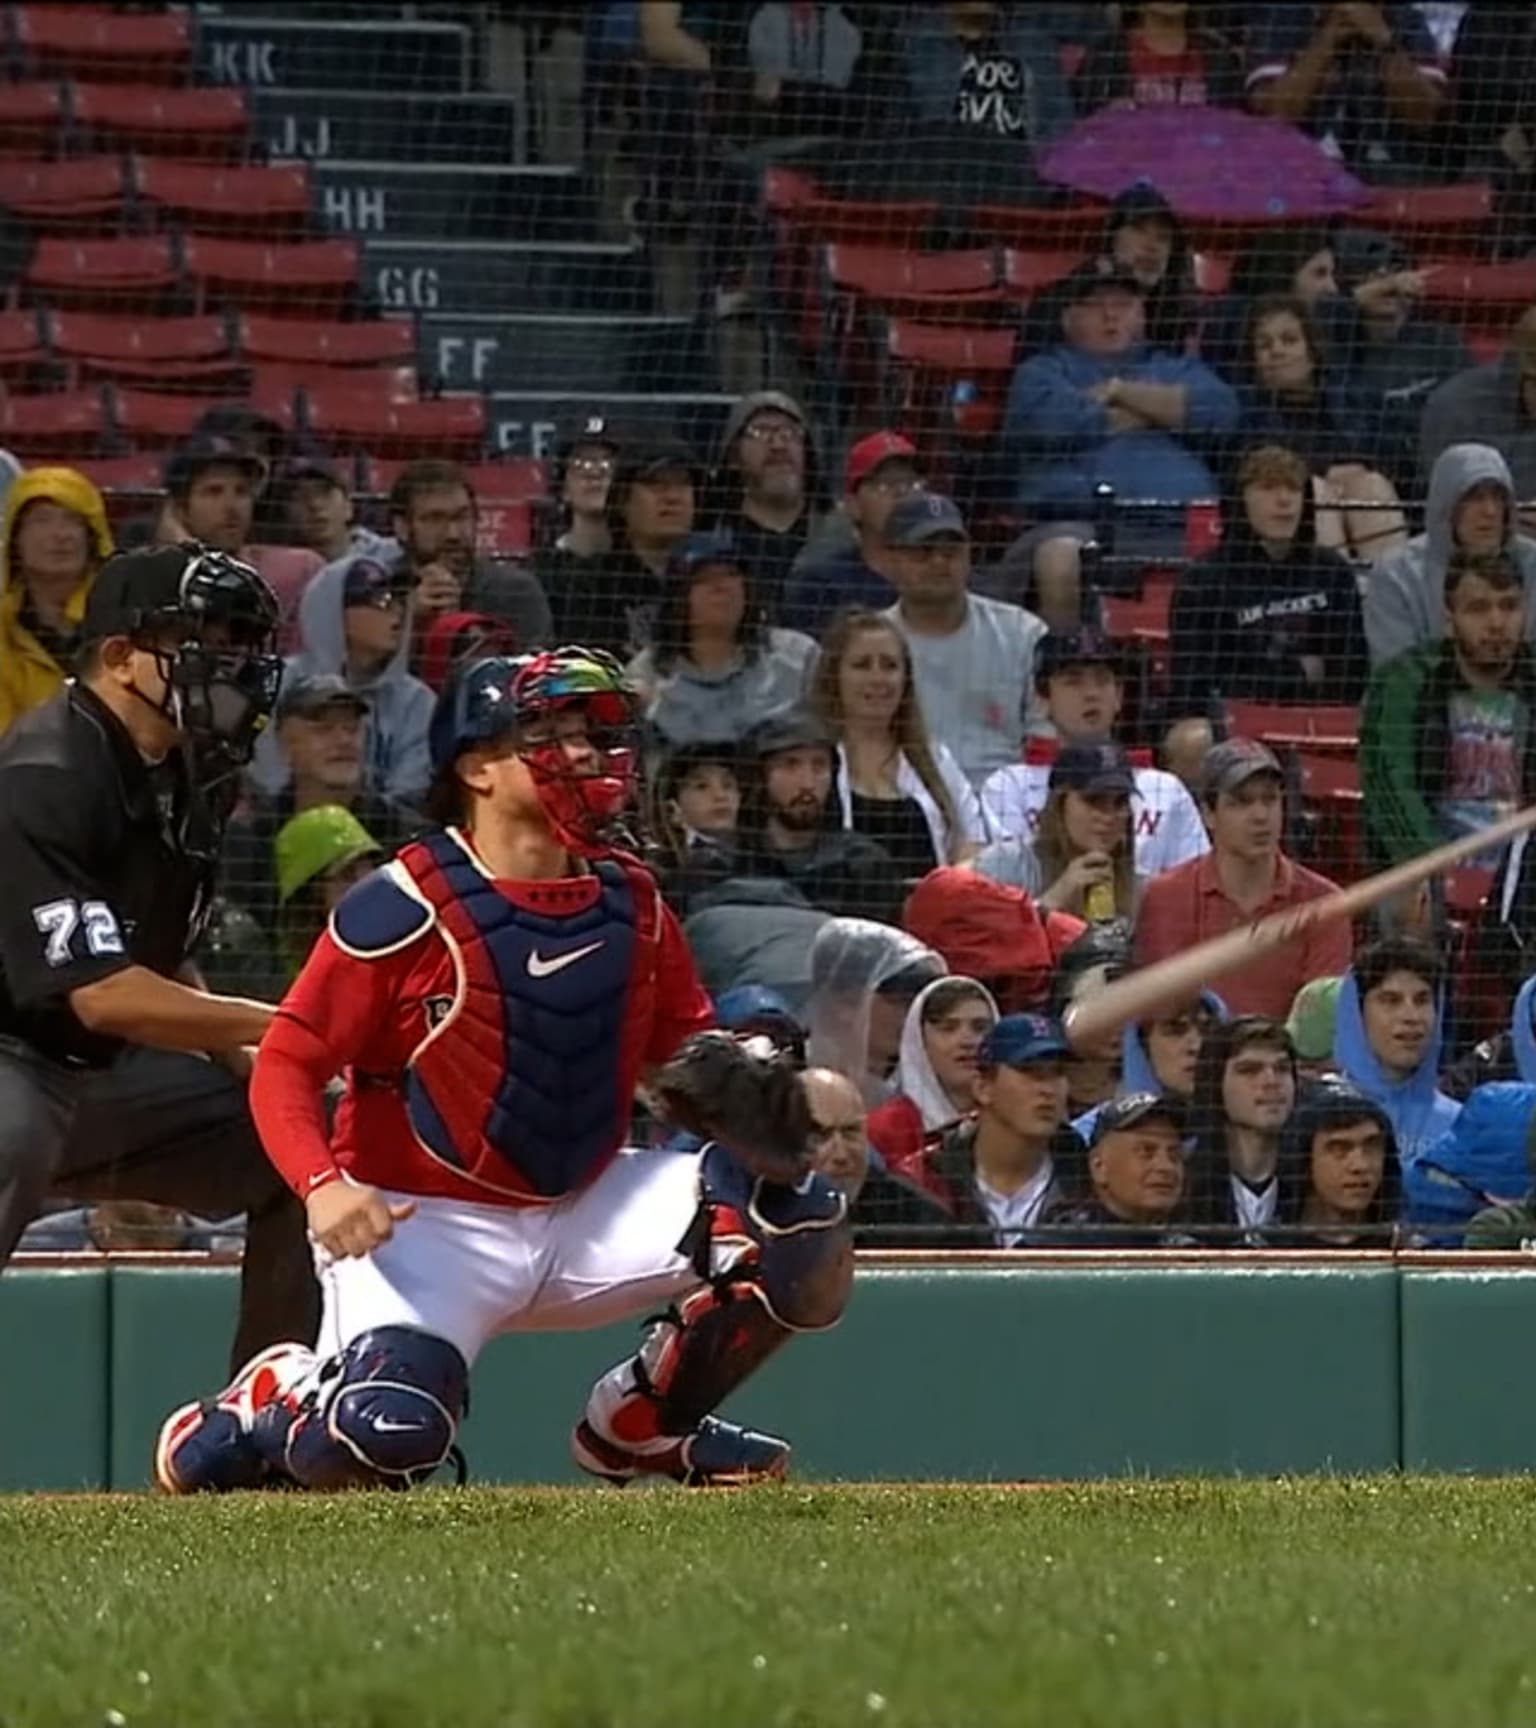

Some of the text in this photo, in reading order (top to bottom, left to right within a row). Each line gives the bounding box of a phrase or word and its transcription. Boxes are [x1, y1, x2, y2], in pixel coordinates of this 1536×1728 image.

[213, 42, 275, 82] KK
[270, 116, 330, 156] JJ
[326, 187, 385, 231] HH
[378, 268, 439, 308] GG
[439, 339, 499, 380] FF
[32, 898, 125, 968] 72
